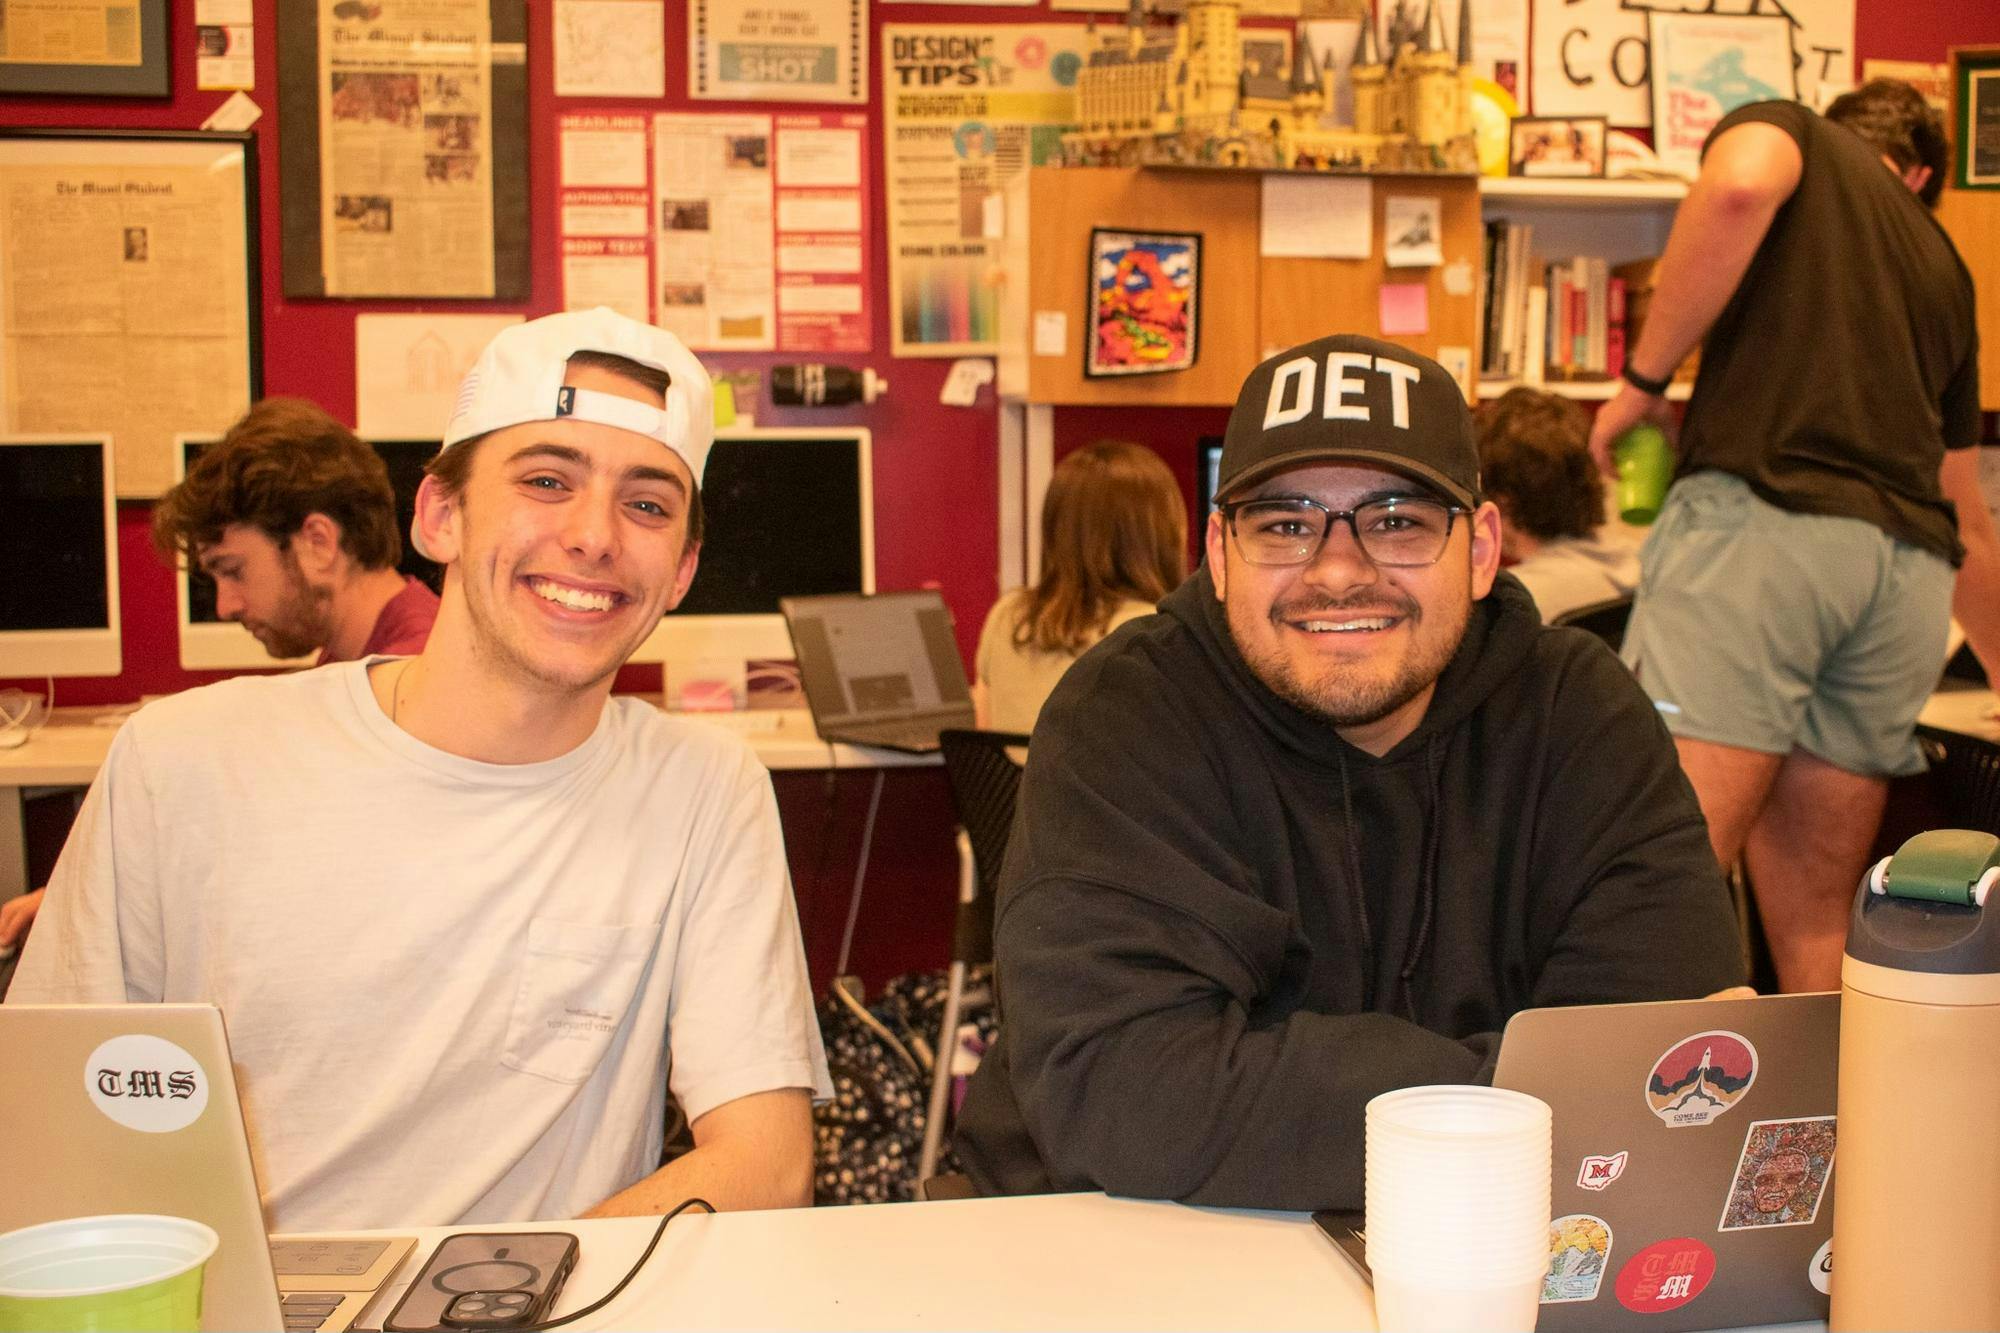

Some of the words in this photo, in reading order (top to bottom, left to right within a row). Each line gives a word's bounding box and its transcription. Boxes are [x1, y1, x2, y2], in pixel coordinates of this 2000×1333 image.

[893, 36, 980, 61] DESIGN
[739, 57, 819, 82] SHOT
[894, 65, 979, 86] TIPS
[1262, 352, 1421, 431] DET
[97, 1068, 197, 1100] TMS
[1588, 1163, 1614, 1179] M
